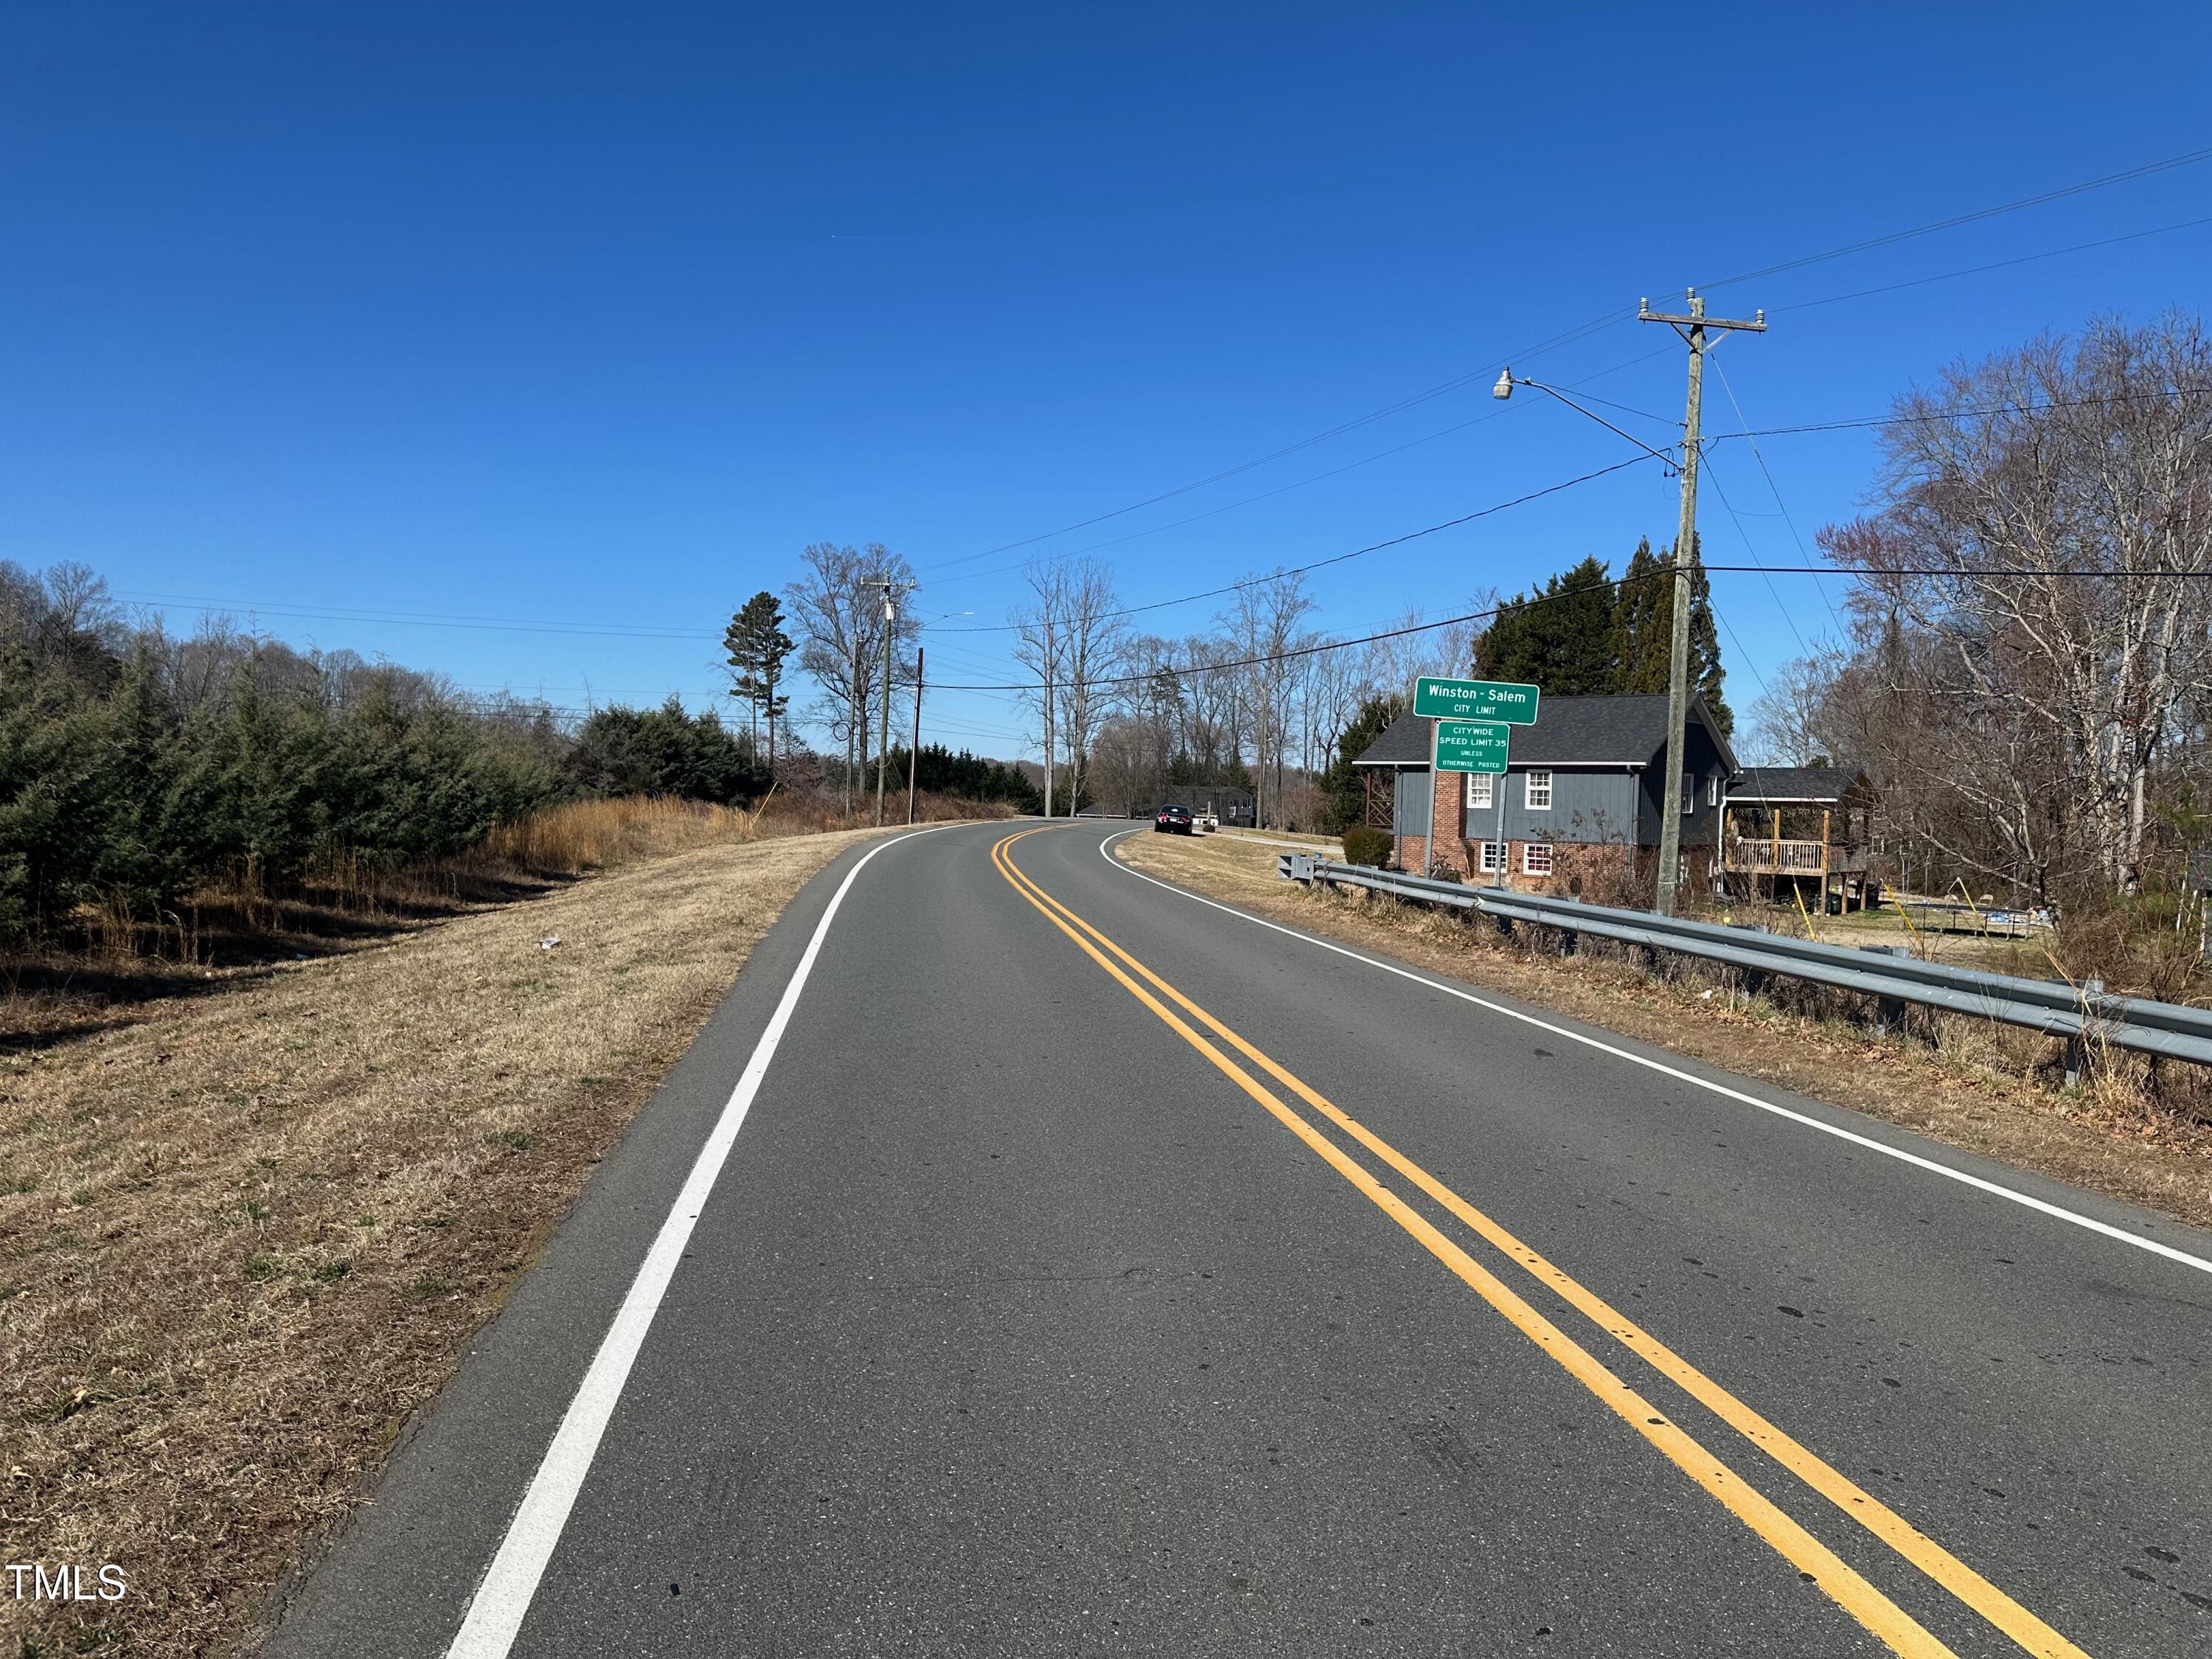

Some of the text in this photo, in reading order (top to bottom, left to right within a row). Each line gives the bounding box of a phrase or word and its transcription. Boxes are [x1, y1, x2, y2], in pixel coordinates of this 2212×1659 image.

[1429, 684, 1476, 699] Winston
[1488, 689, 1526, 703] Salem
[1454, 704, 1496, 714] CITY LIMIT
[1453, 727, 1494, 736] CITYWIDE
[1439, 737, 1506, 748] SPEED LIMIT 35
[1442, 759, 1474, 768] OTHERWISE
